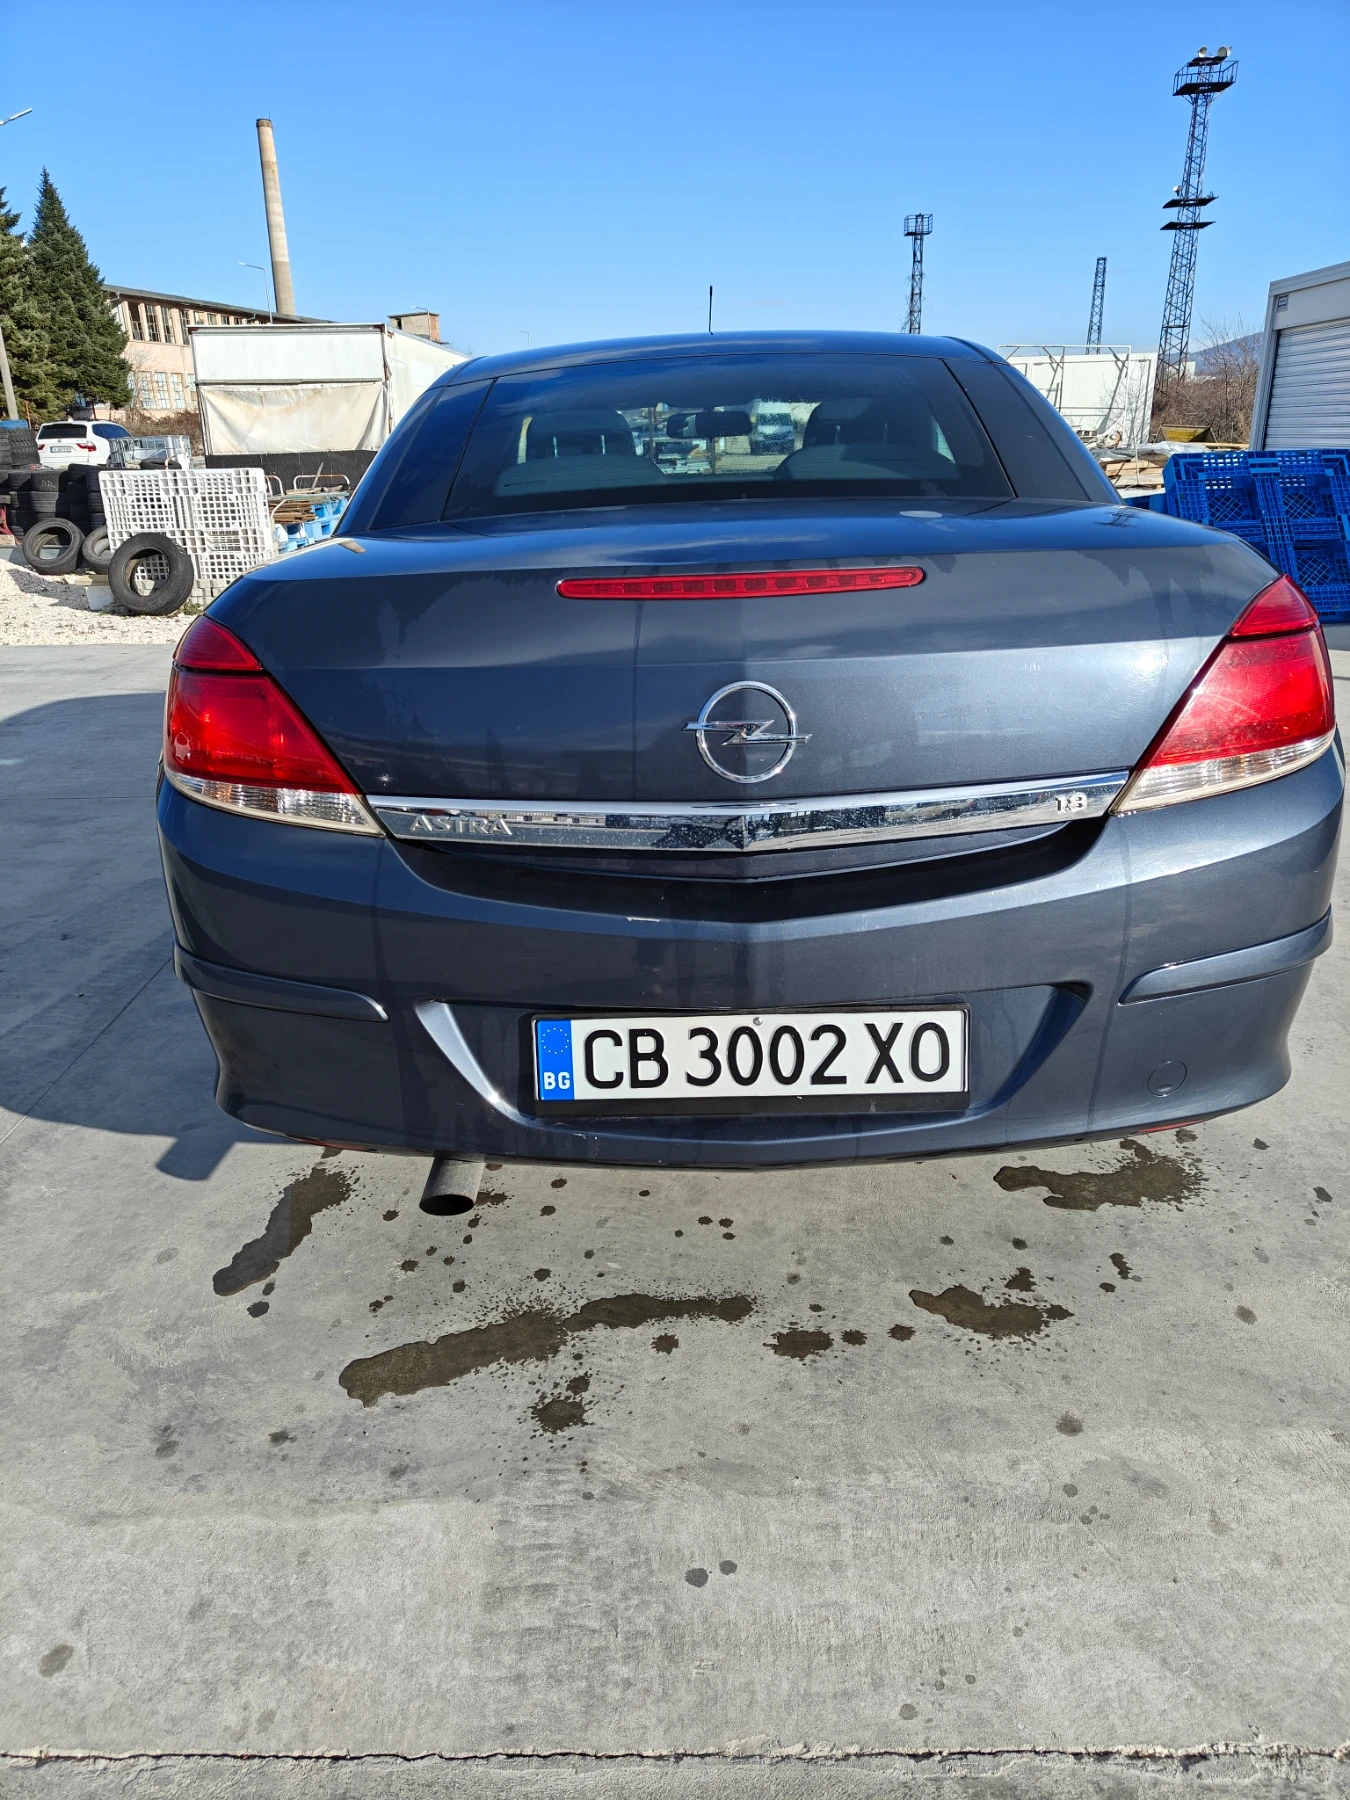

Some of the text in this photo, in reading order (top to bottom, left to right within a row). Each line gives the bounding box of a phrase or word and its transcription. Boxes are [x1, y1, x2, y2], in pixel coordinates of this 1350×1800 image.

[410, 814, 513, 836] ASTRA
[584, 1022, 950, 1089] CB 3002 XO
[543, 1071, 571, 1090] BG
